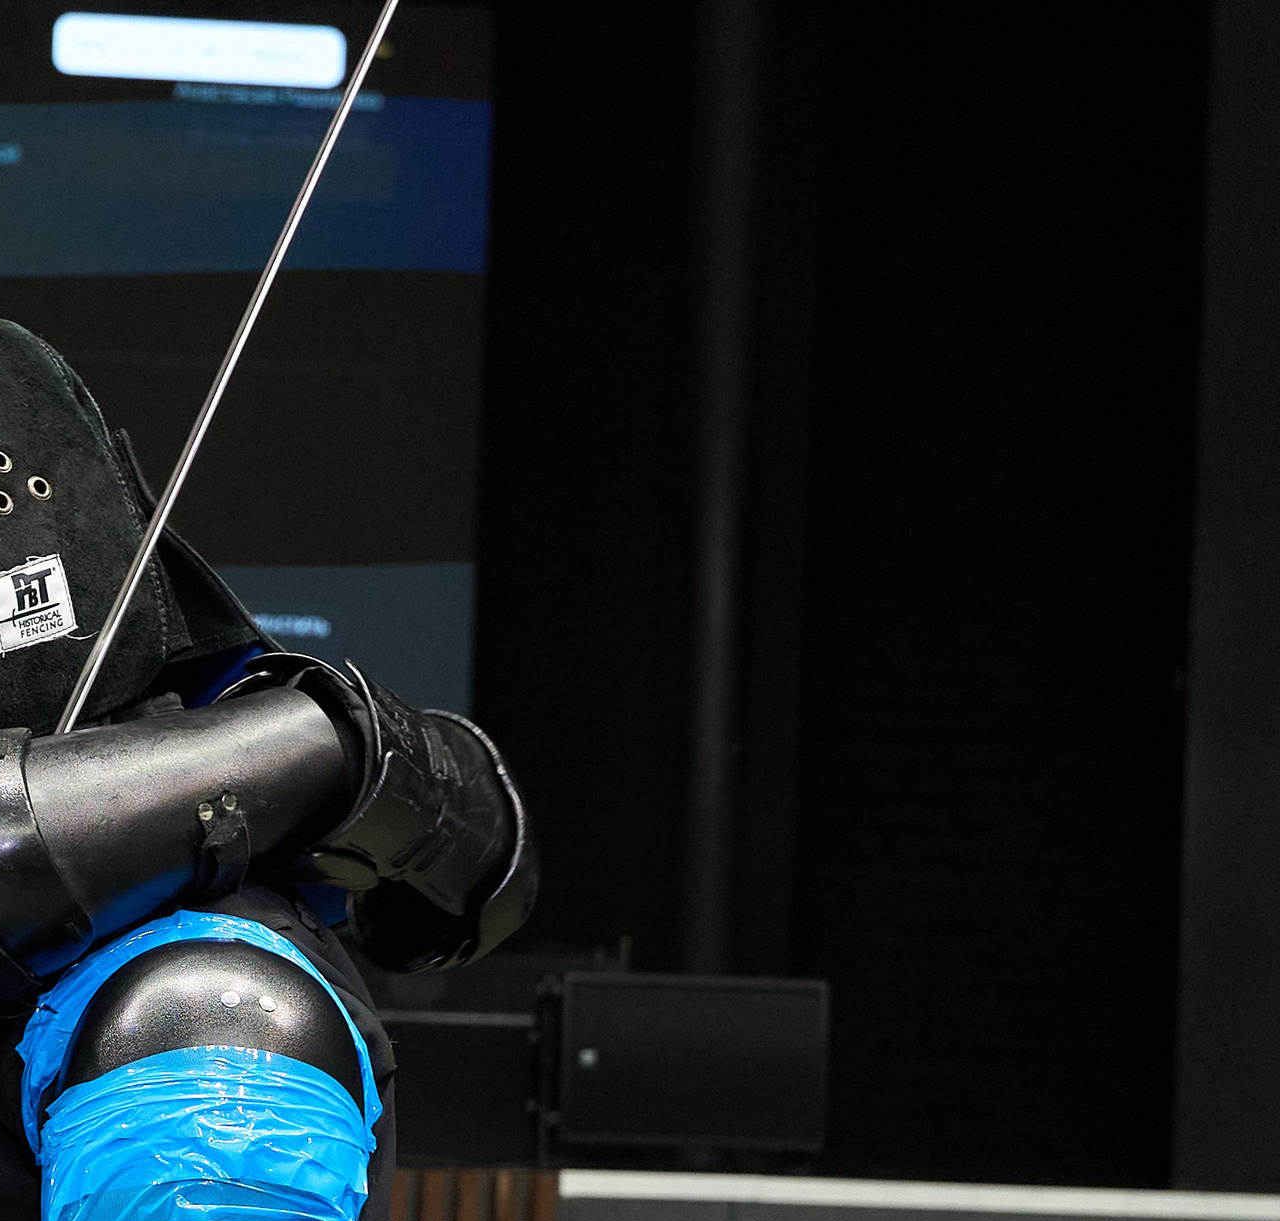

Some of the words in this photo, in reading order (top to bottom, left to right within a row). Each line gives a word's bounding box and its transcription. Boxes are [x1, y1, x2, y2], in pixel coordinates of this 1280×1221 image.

[11, 568, 52, 611] PBT
[18, 610, 61, 629] HISTORICAL
[21, 618, 64, 639] FENCING
